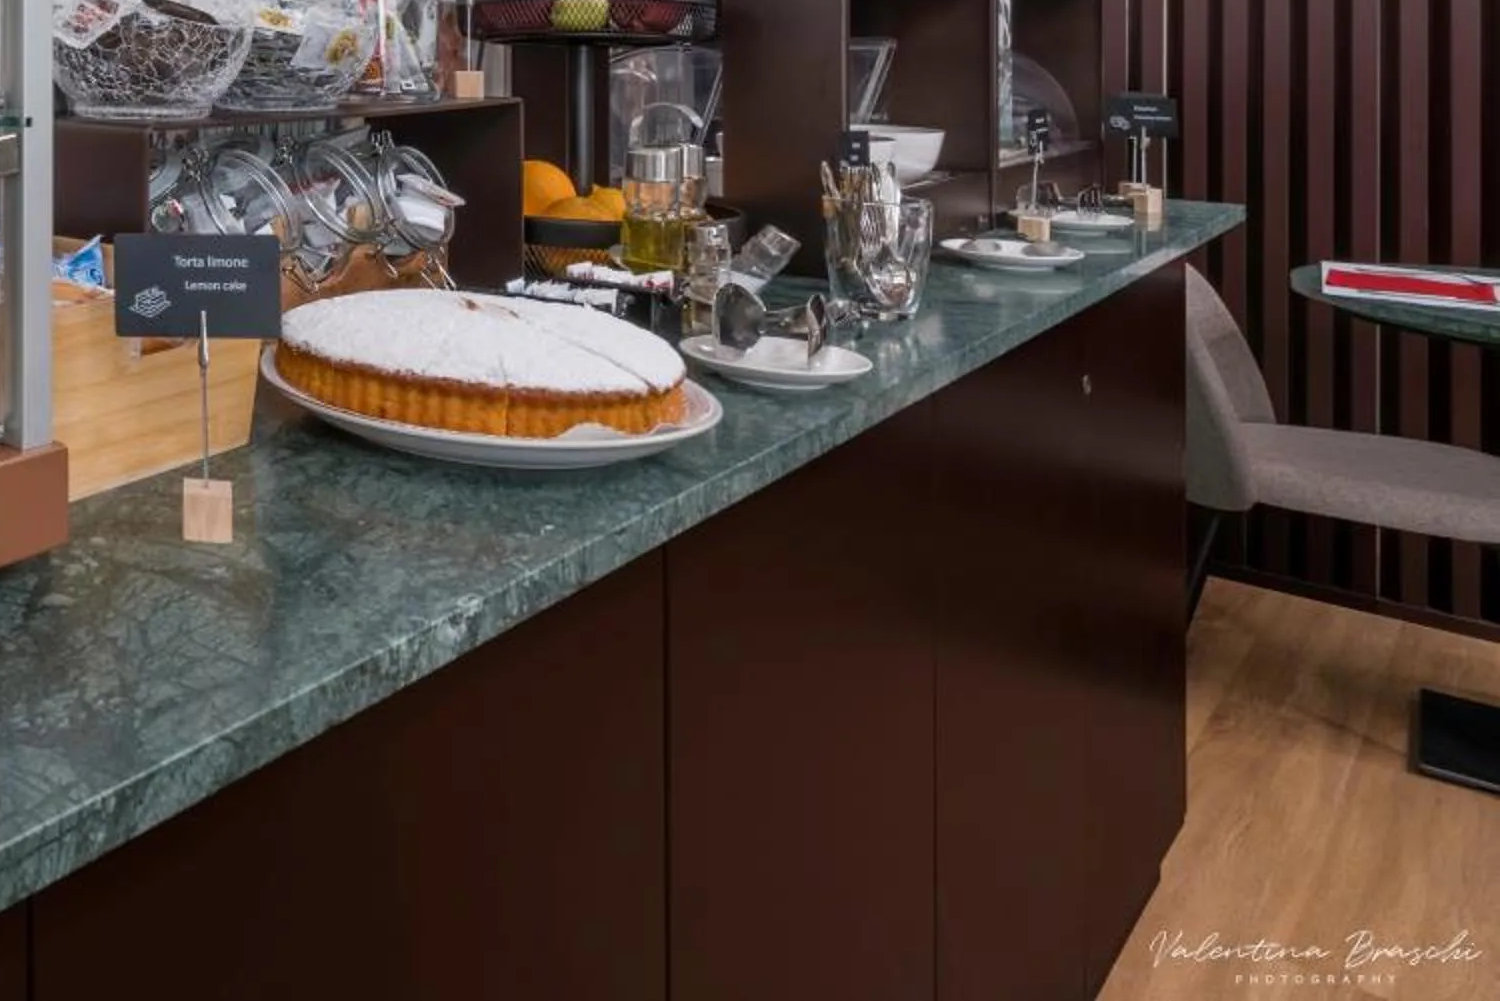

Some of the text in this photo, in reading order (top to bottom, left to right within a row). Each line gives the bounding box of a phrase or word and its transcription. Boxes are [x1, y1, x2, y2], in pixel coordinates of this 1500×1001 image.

[174, 254, 249, 268] Torta limone
[184, 279, 247, 292] Lemon cake
